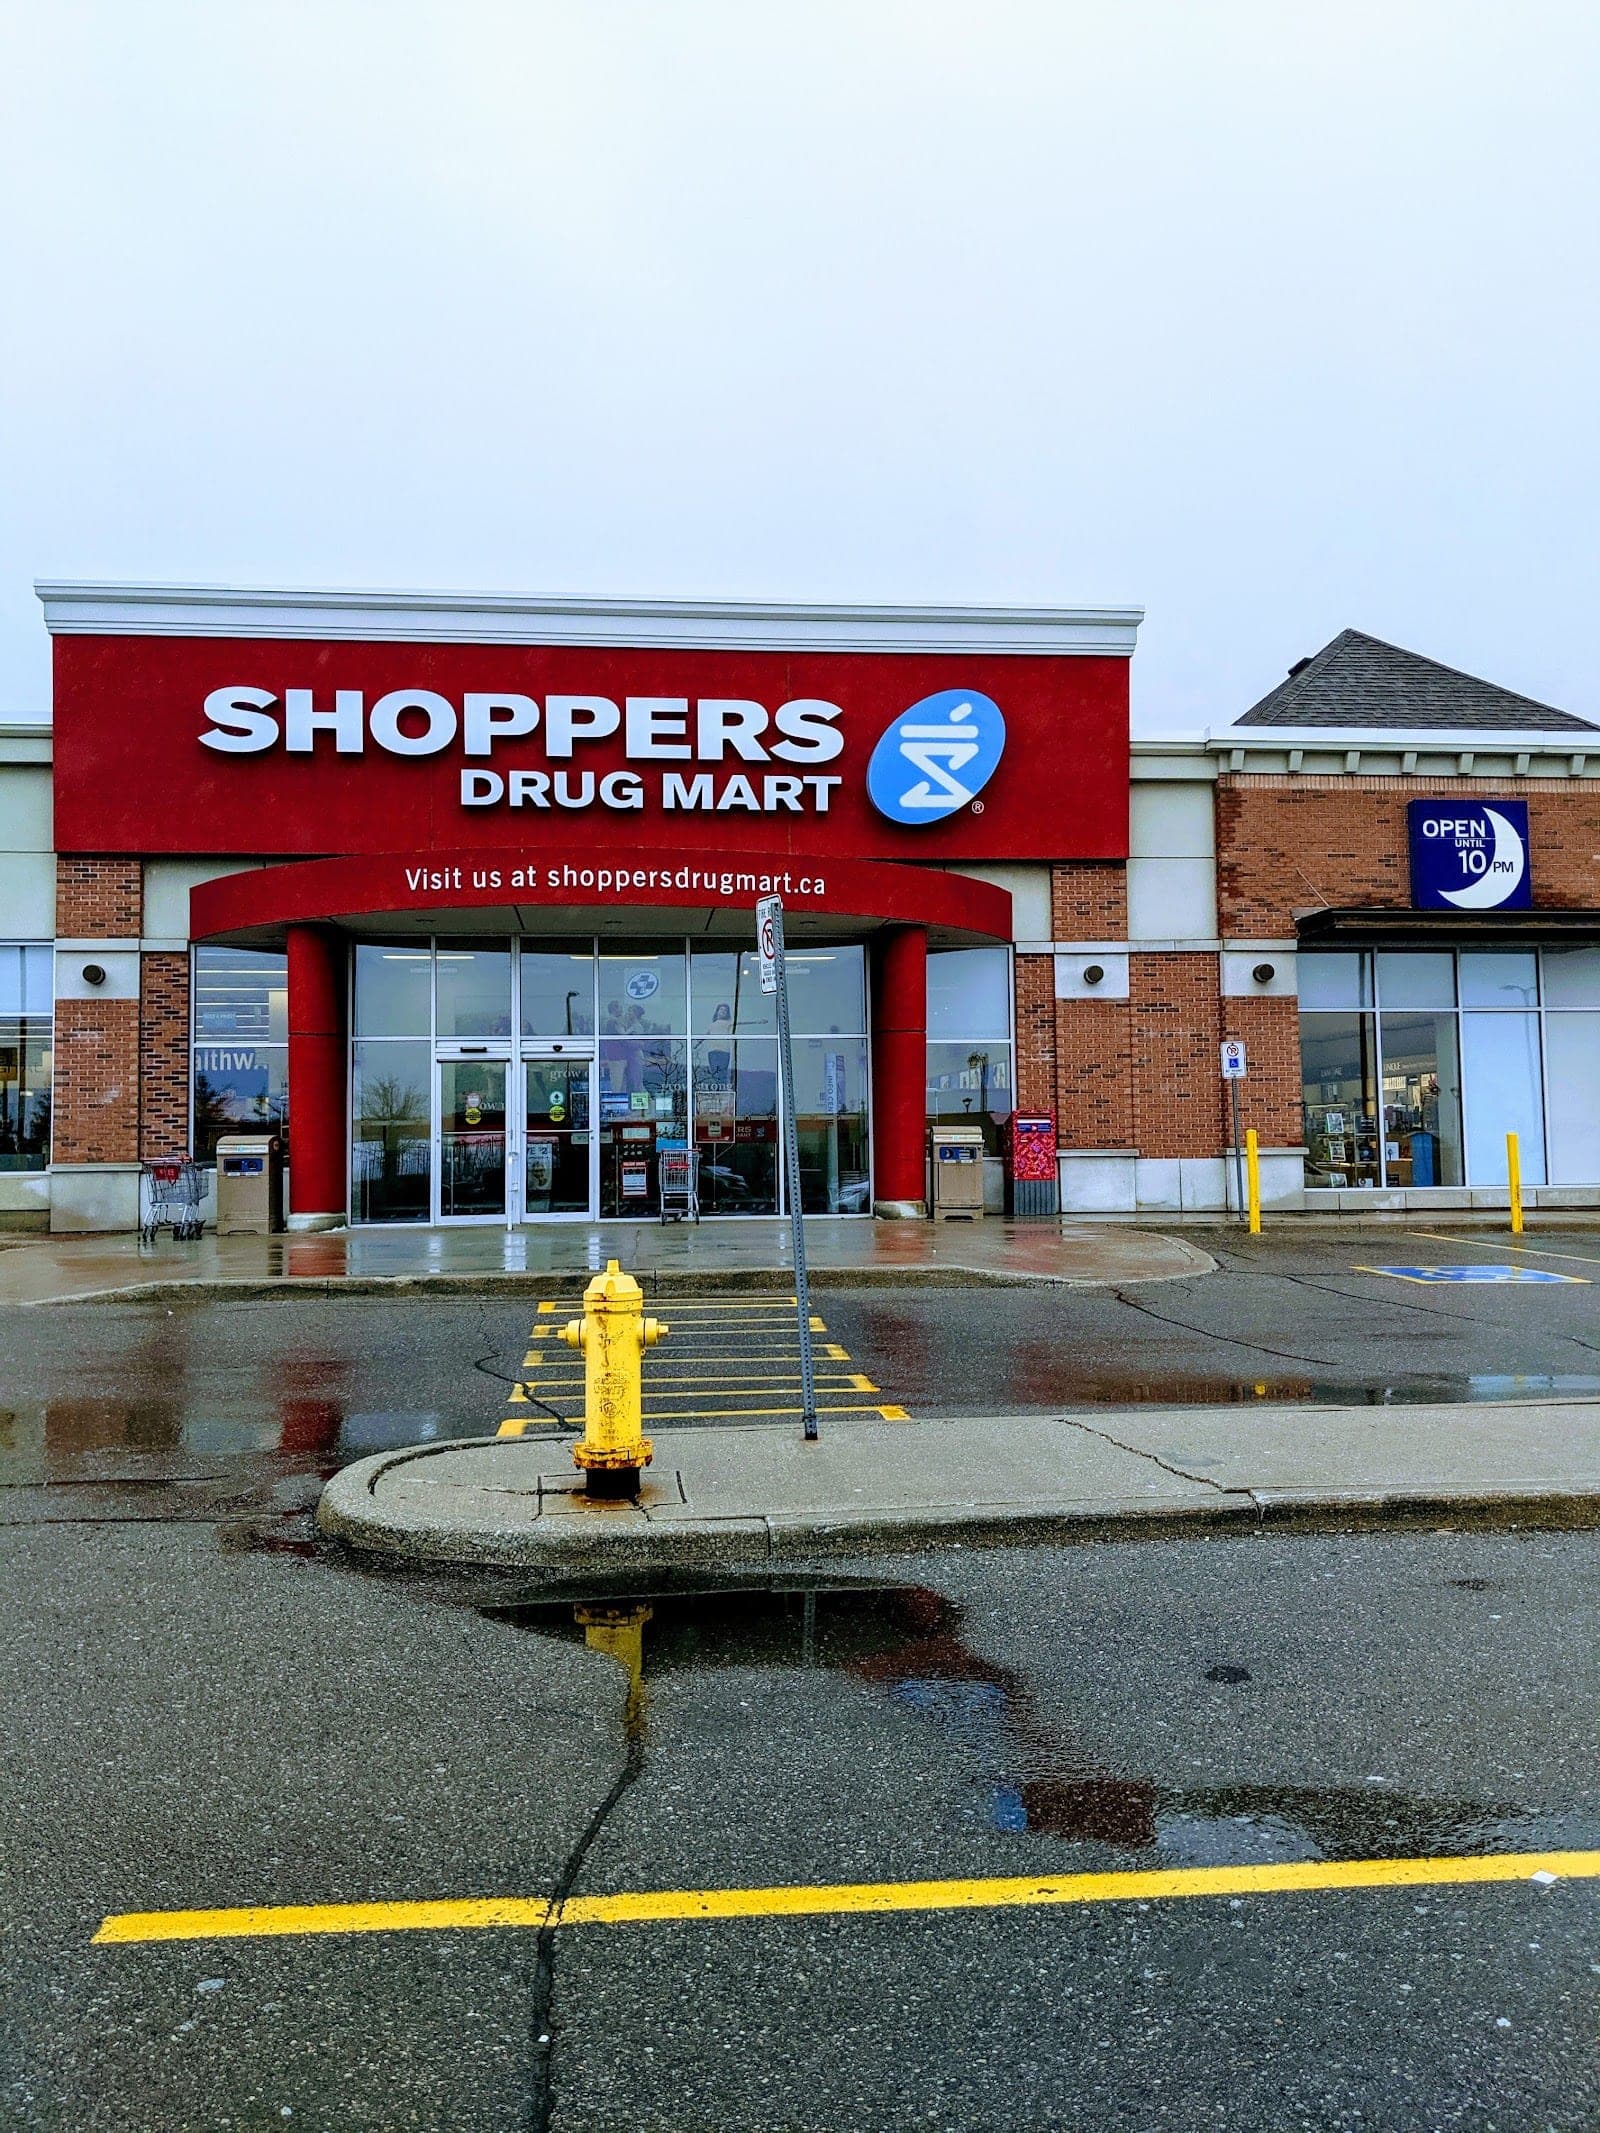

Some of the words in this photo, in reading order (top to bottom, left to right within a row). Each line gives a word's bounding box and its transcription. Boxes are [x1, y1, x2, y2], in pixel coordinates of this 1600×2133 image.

[198, 686, 844, 763] SHOPPERS
[461, 769, 644, 808] DRUG
[663, 773, 842, 811] MART
[1422, 820, 1486, 837] OPEN
[1455, 840, 1486, 848] UNTIL
[1458, 850, 1487, 874] 10
[1493, 861, 1514, 873] PM
[405, 868, 461, 891] Visit
[473, 870, 502, 889] us
[511, 866, 537, 887] at
[548, 865, 826, 895] shoppersdrugmart.ca
